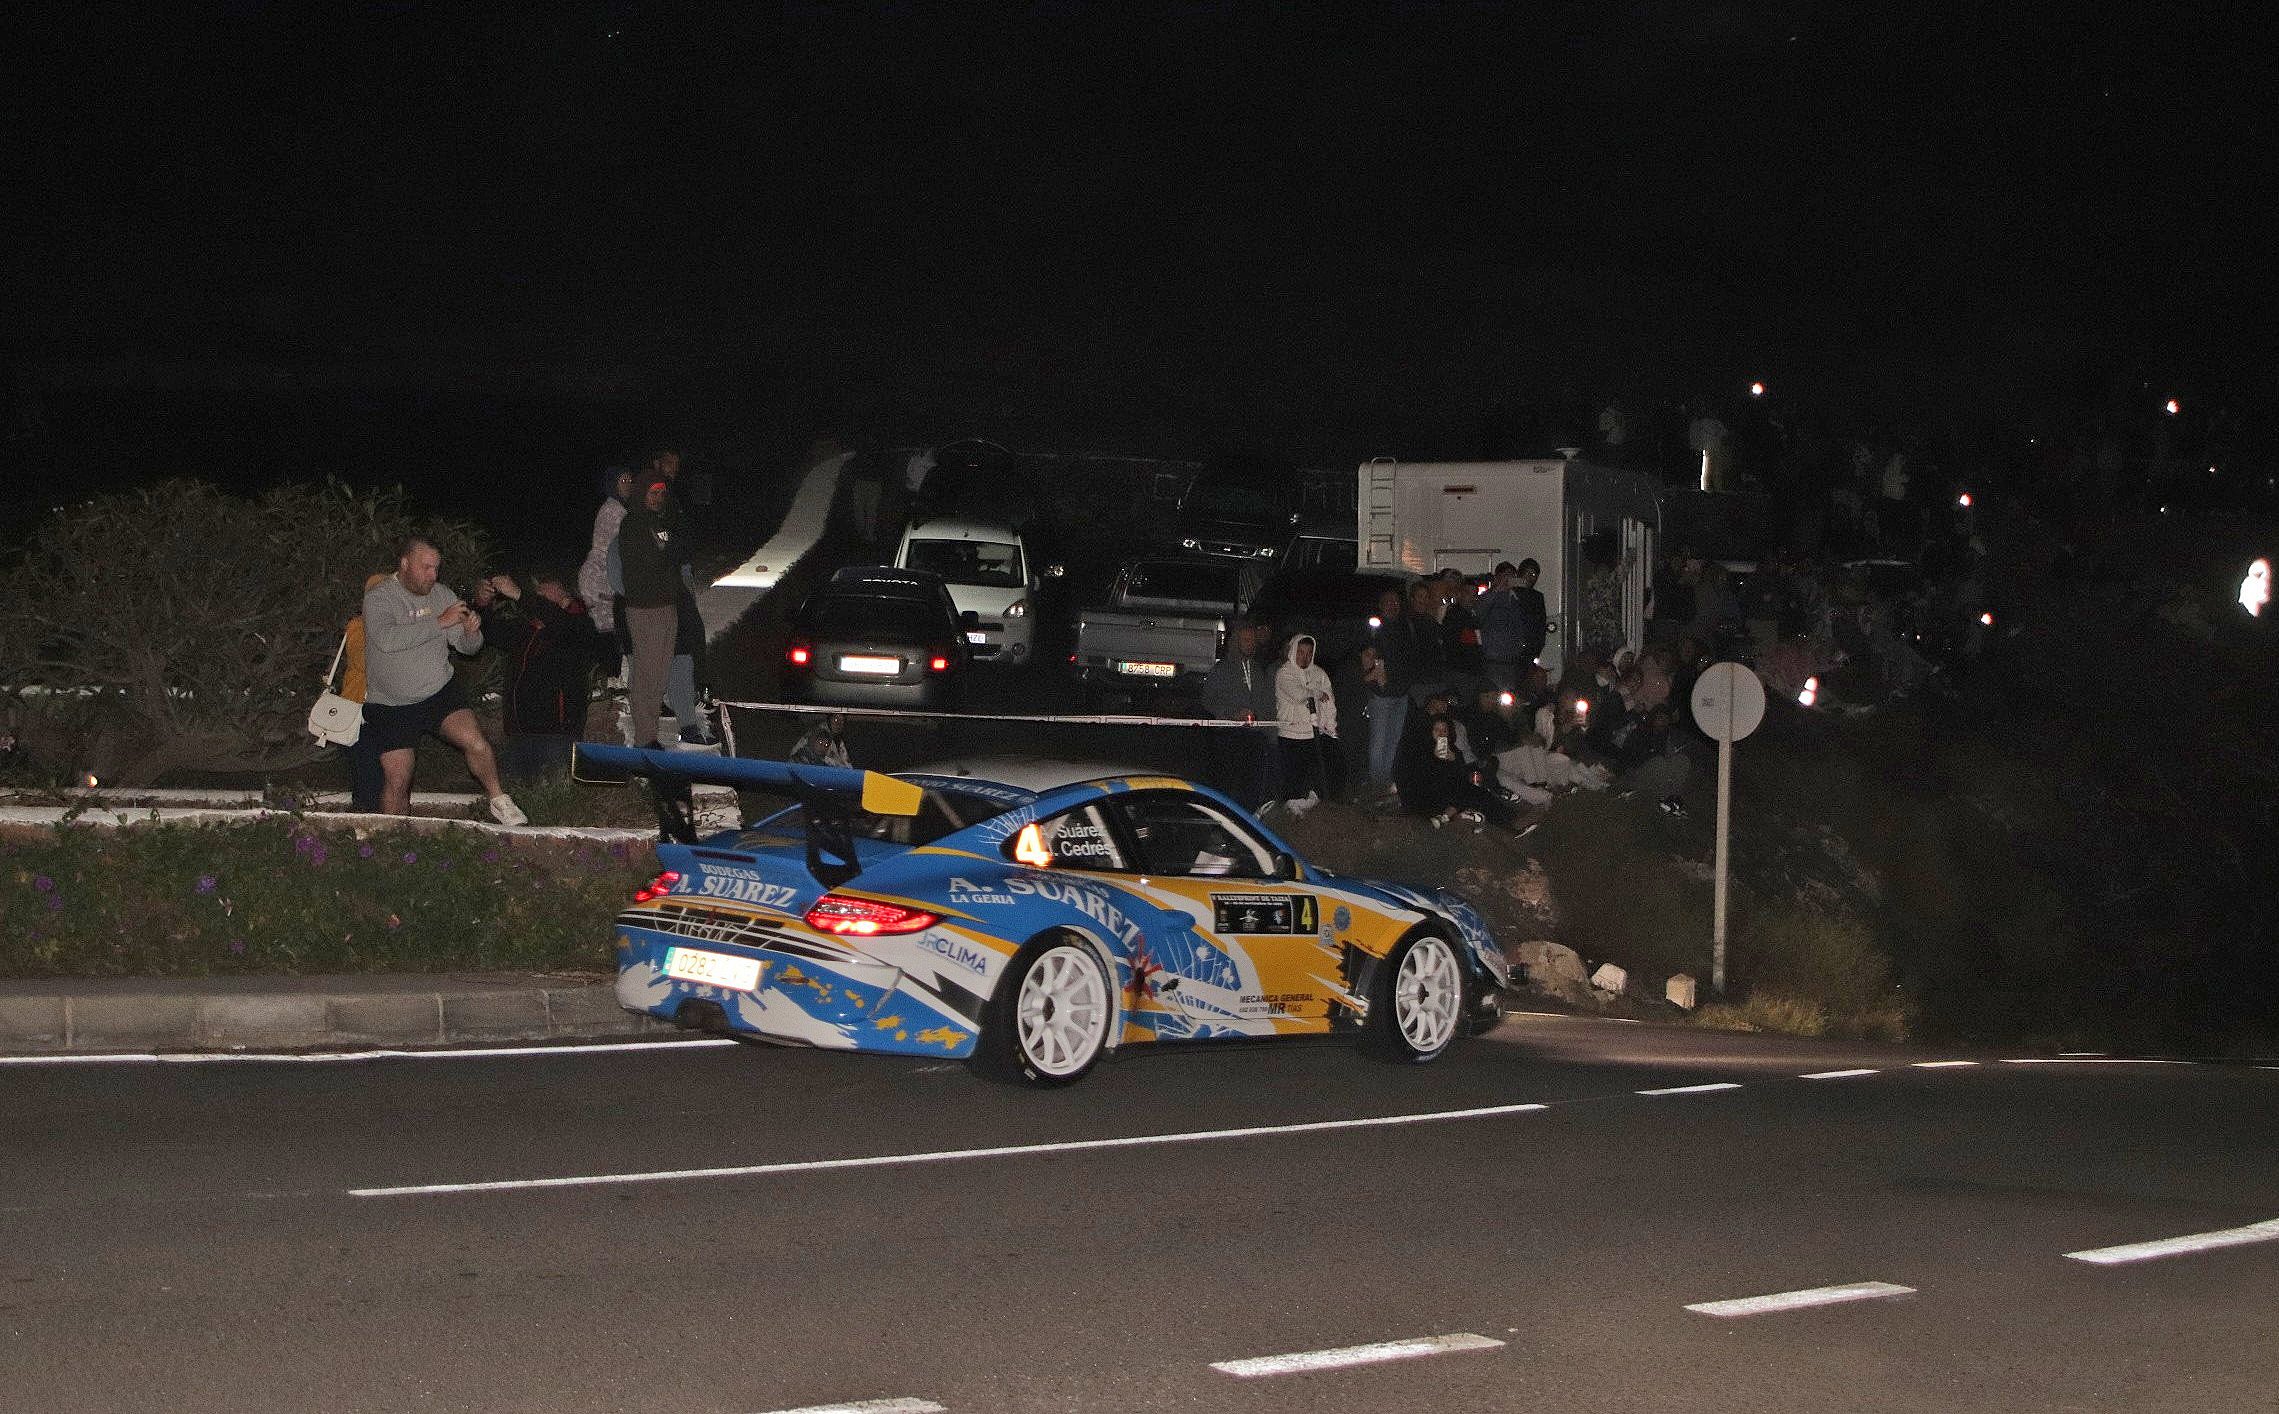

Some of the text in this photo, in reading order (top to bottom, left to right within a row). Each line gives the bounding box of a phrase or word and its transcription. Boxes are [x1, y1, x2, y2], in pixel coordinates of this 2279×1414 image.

[1128, 665, 1172, 675] 8758 CRP
[1016, 823, 1053, 867] 4
[1060, 840, 1113, 857] Cedrés
[699, 863, 760, 881] BODEGAS
[698, 875, 798, 907] SUAREZ
[950, 894, 1015, 905] LA GERIA
[948, 877, 994, 893] A.
[1003, 877, 1141, 951] SUAREZ
[1302, 898, 1313, 931] 4
[678, 954, 717, 978] 0282
[1240, 993, 1313, 1003] MECANICA GENERAL
[1267, 1003, 1285, 1014] MR
